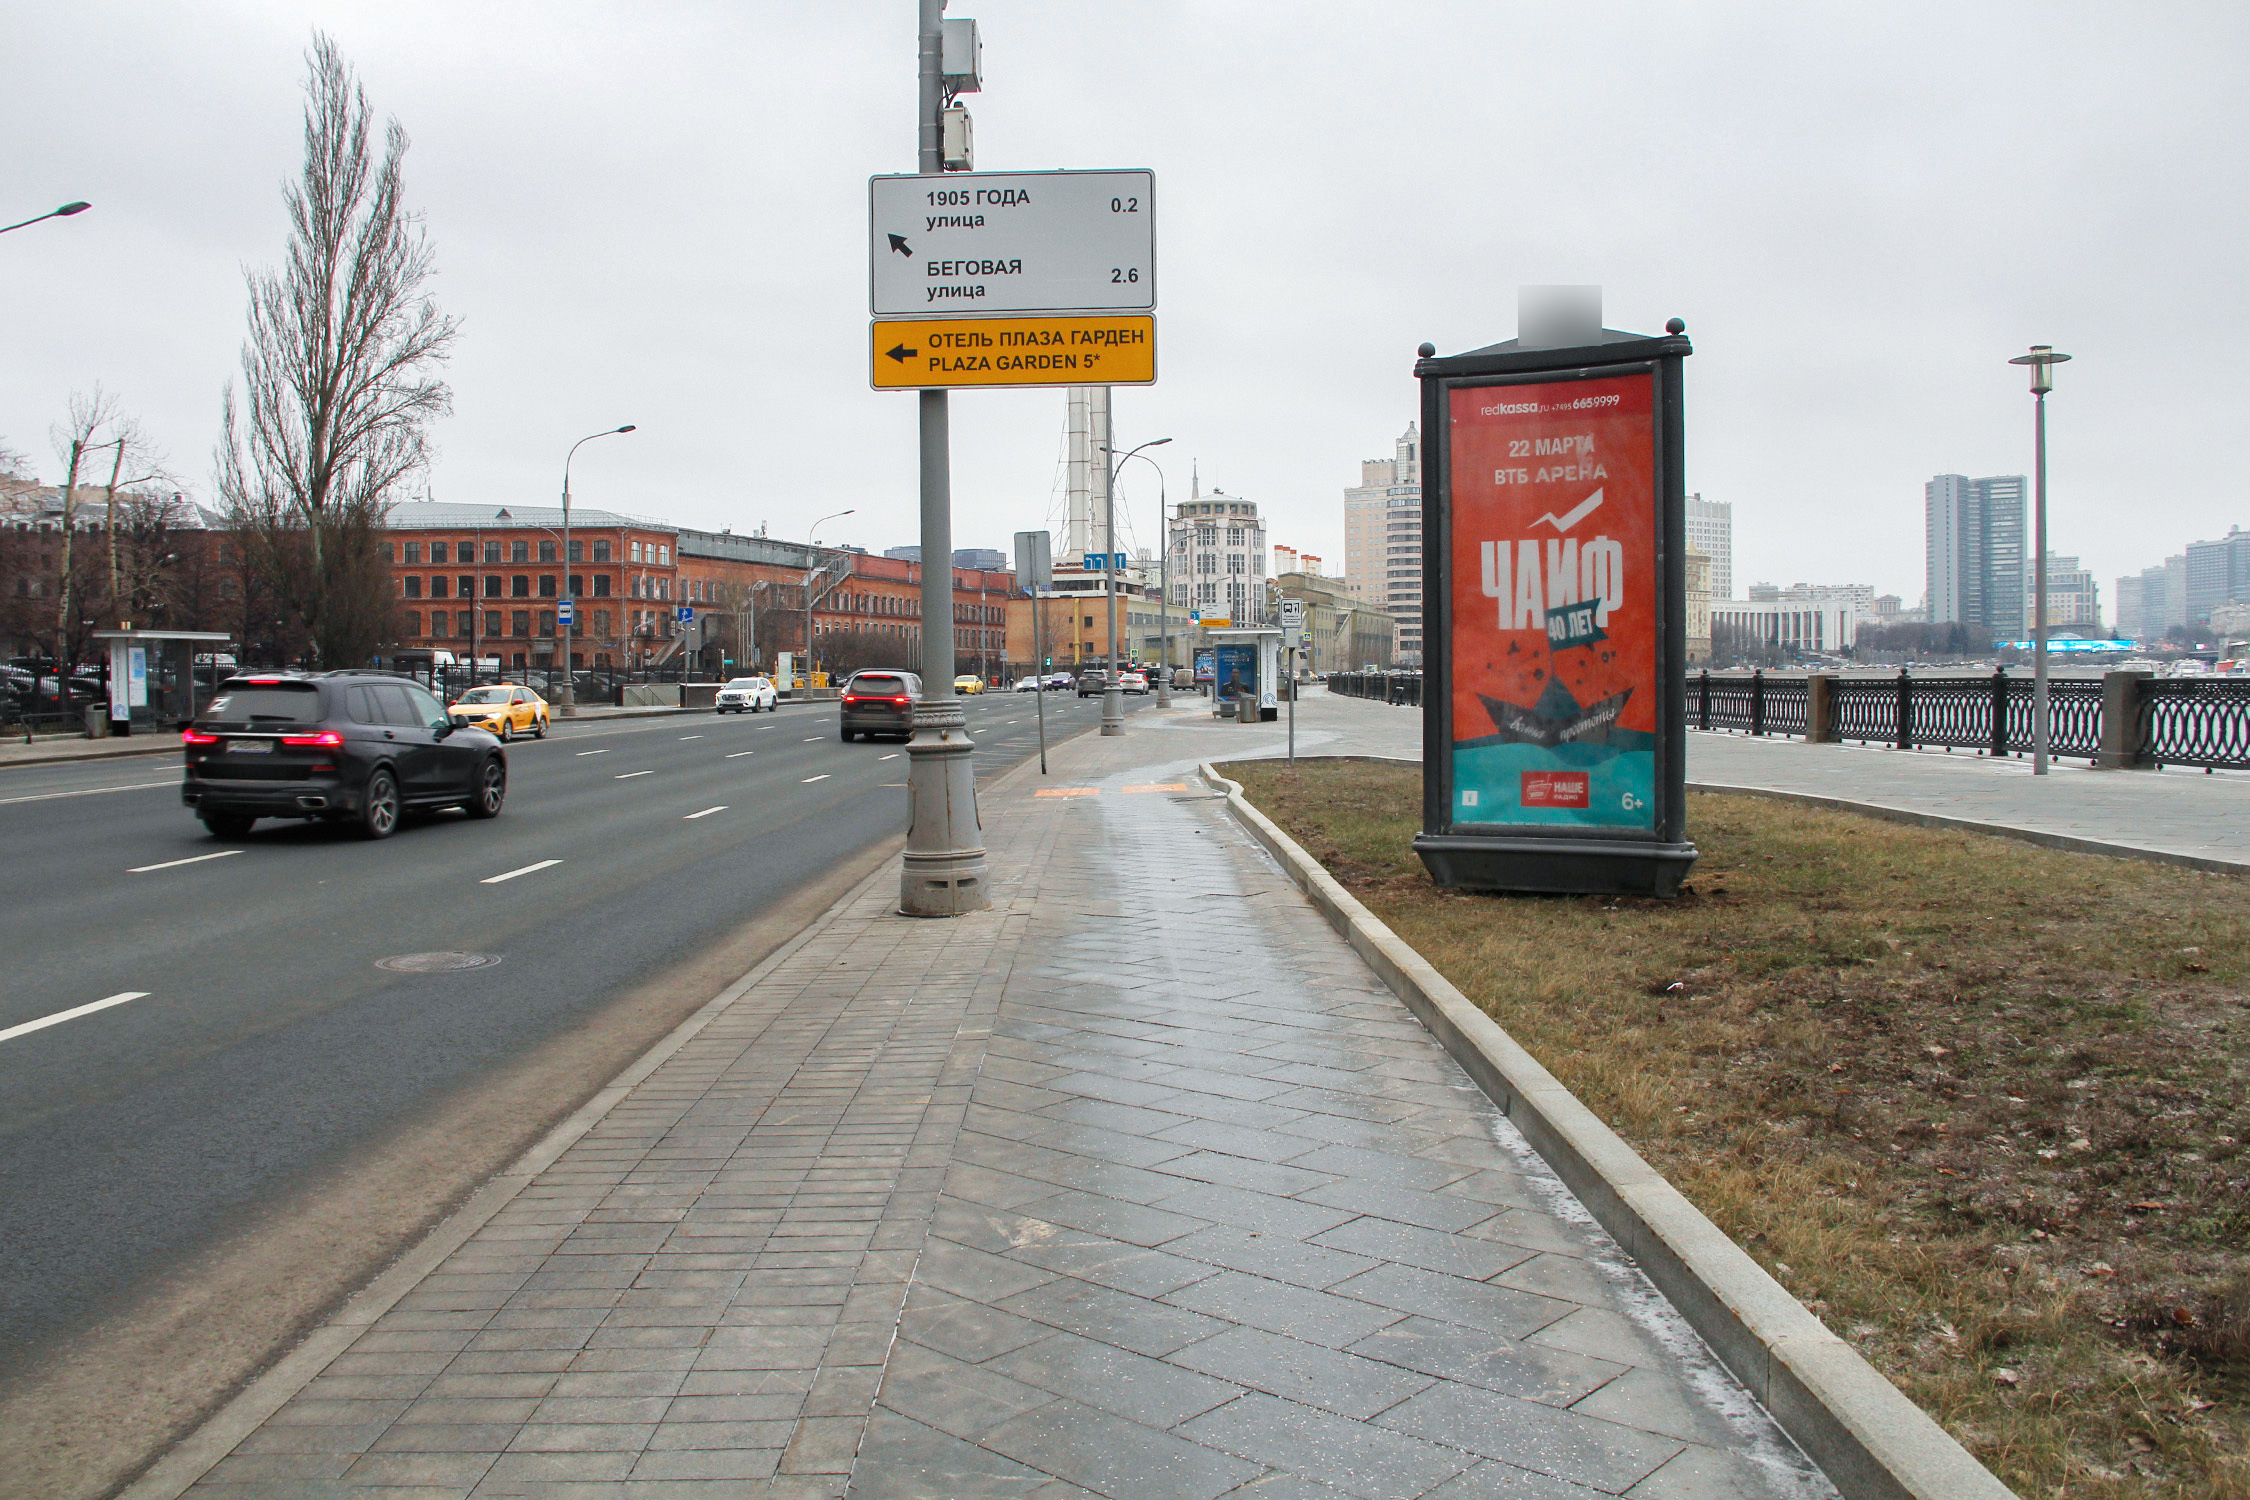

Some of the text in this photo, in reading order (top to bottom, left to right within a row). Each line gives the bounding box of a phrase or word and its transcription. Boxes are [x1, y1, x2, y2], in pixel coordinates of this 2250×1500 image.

[926, 189, 1030, 207] 1905 ГОДА
[1111, 197, 1138, 213] 0.2
[926, 213, 985, 231] улица
[927, 259, 1022, 276] БЕГОВАЯ
[1111, 268, 1139, 283] 2.6
[927, 284, 985, 302] улица
[928, 329, 1144, 348] ОТЕЛЬ ПЛАЗА ГАРДЕН
[929, 356, 991, 371] PLAZA
[996, 354, 1077, 370] GARDEN
[1508, 435, 1595, 457] 22 МАРТА
[1495, 464, 1608, 485] ВТБ АРЕНА
[1548, 608, 1593, 640] 40 ЛЕТ
[1553, 781, 1584, 794] НАШЕ
[1621, 792, 1643, 811] 6+
